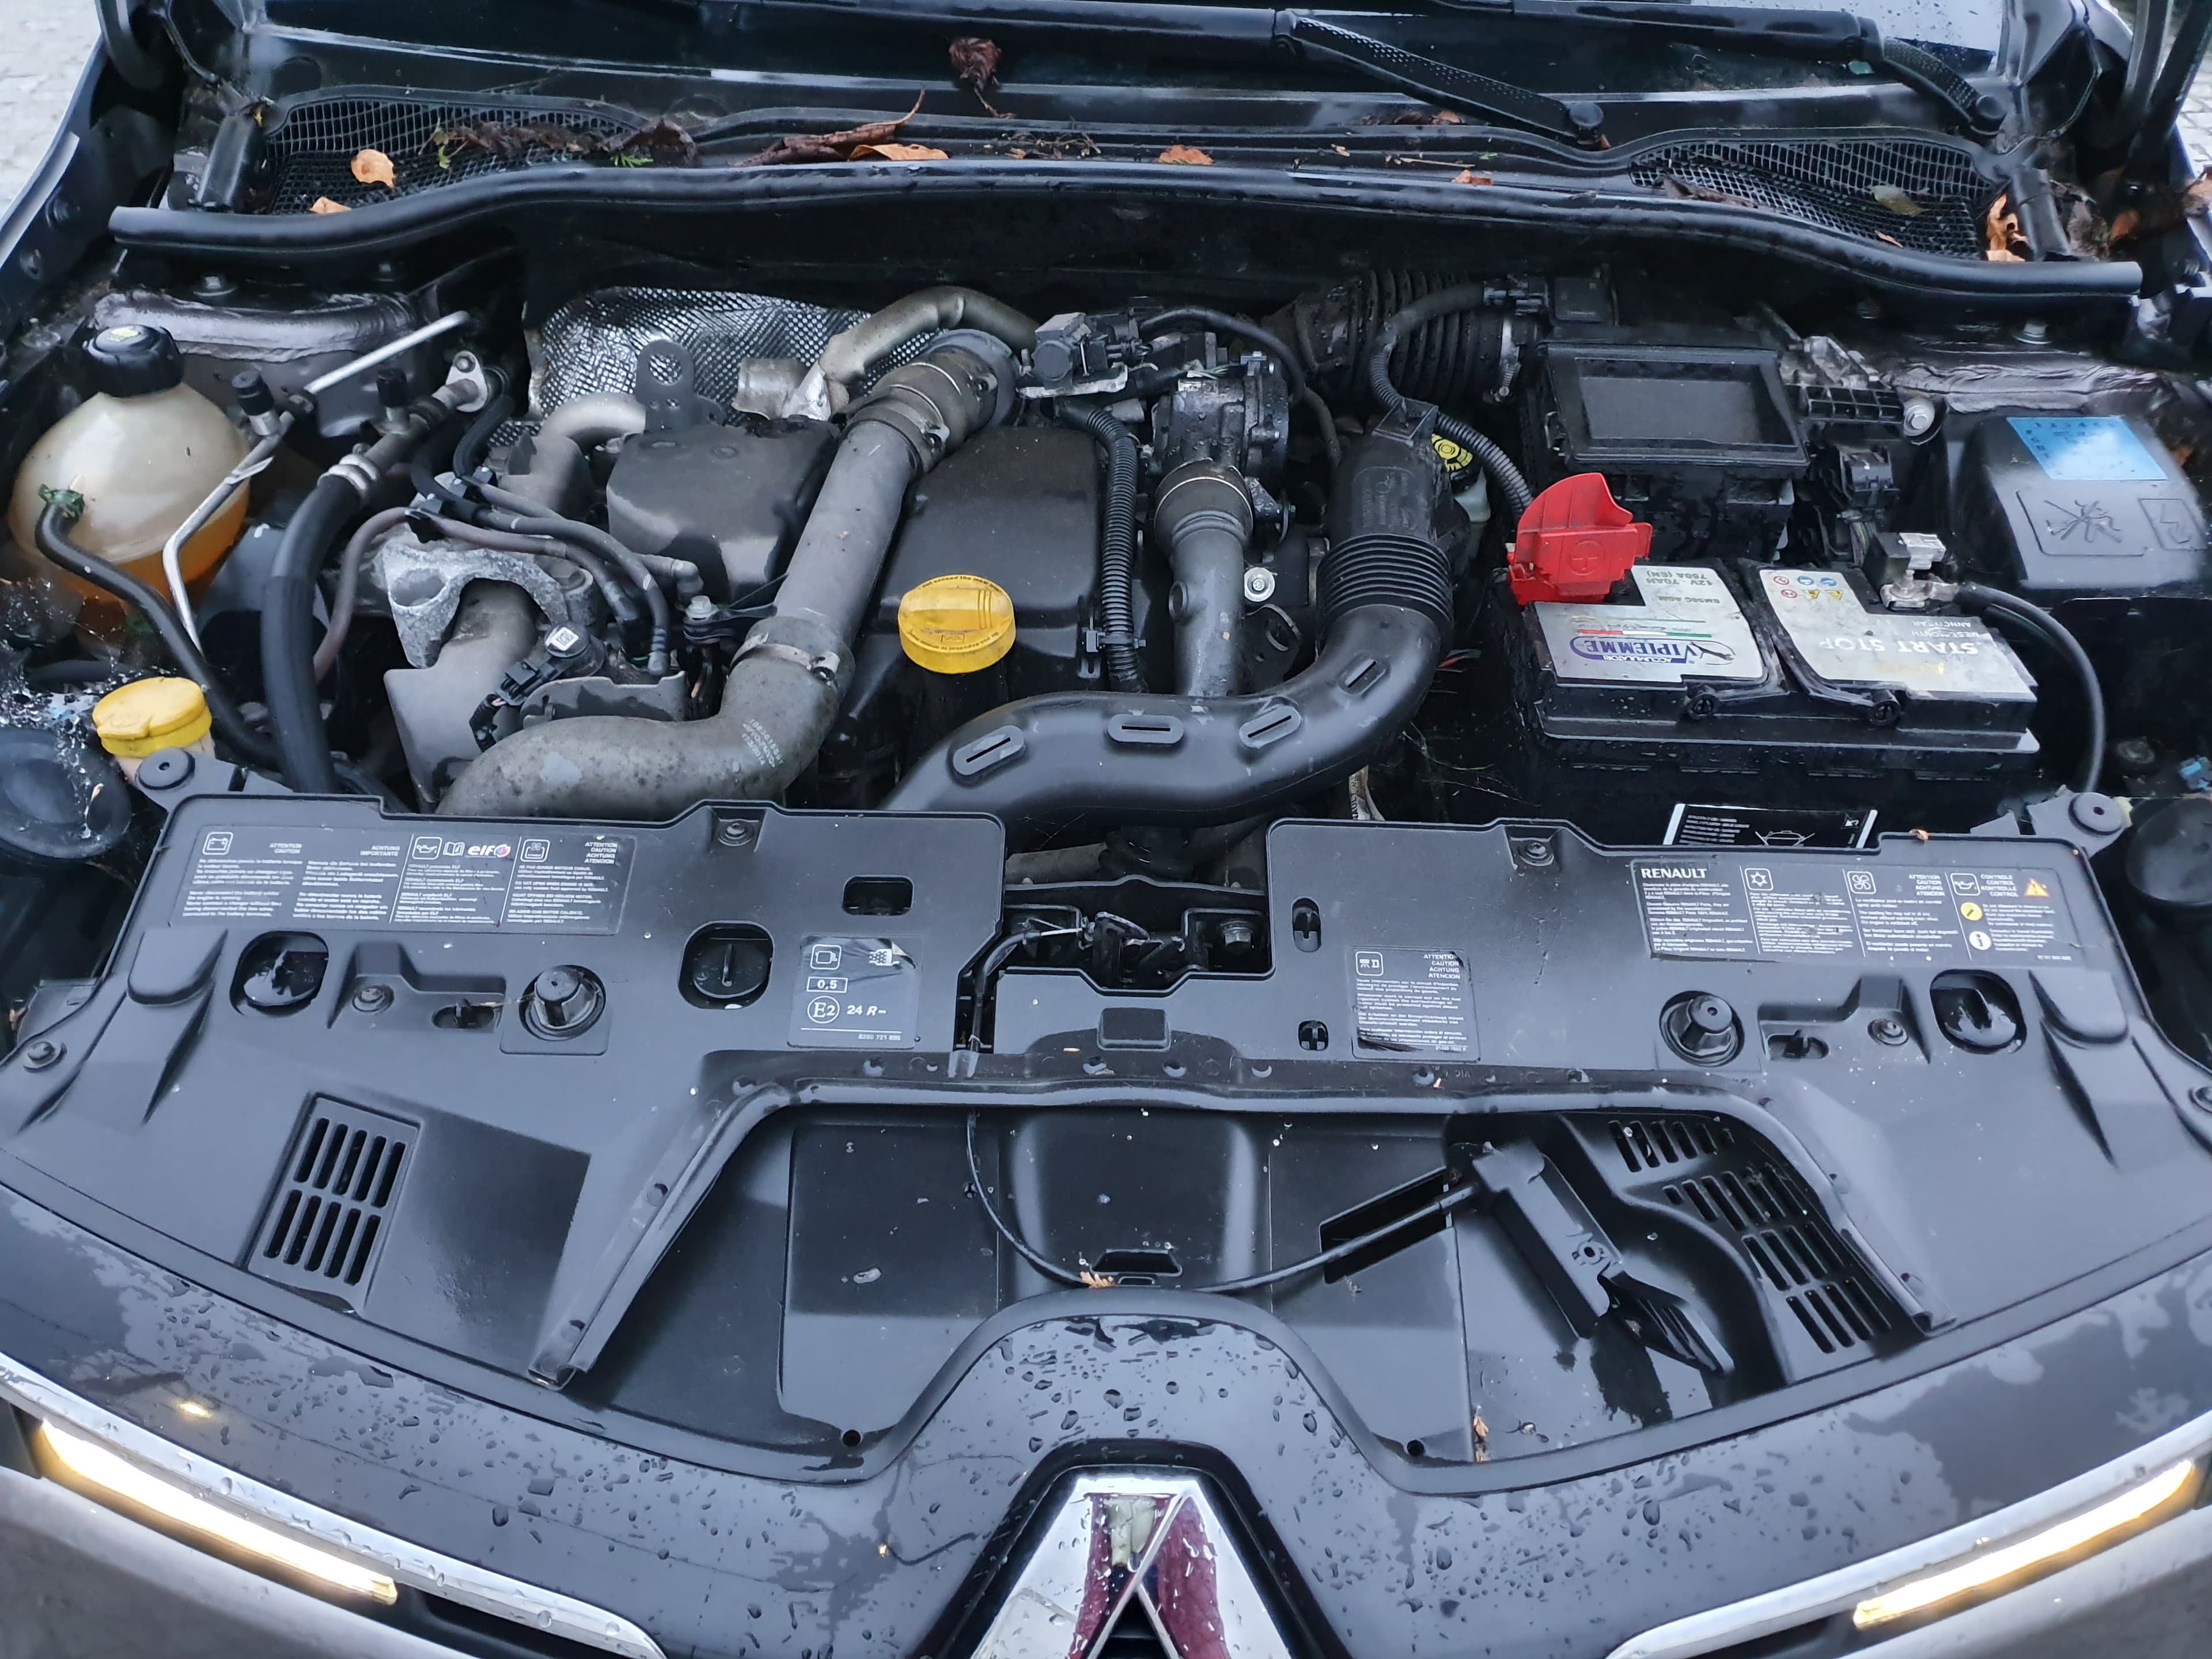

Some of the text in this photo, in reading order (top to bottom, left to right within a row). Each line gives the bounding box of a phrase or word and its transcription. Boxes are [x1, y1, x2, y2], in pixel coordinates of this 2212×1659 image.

[1584, 639, 1698, 658] VIPIEMME
[1897, 641, 1979, 655] START
[1603, 654, 1672, 663] ACCUMULATORI
[468, 845, 495, 855] elf
[1641, 868, 1707, 878] RENAULT
[817, 980, 838, 990] 0,5
[813, 1002, 836, 1018] E2
[846, 1005, 863, 1016] 24
